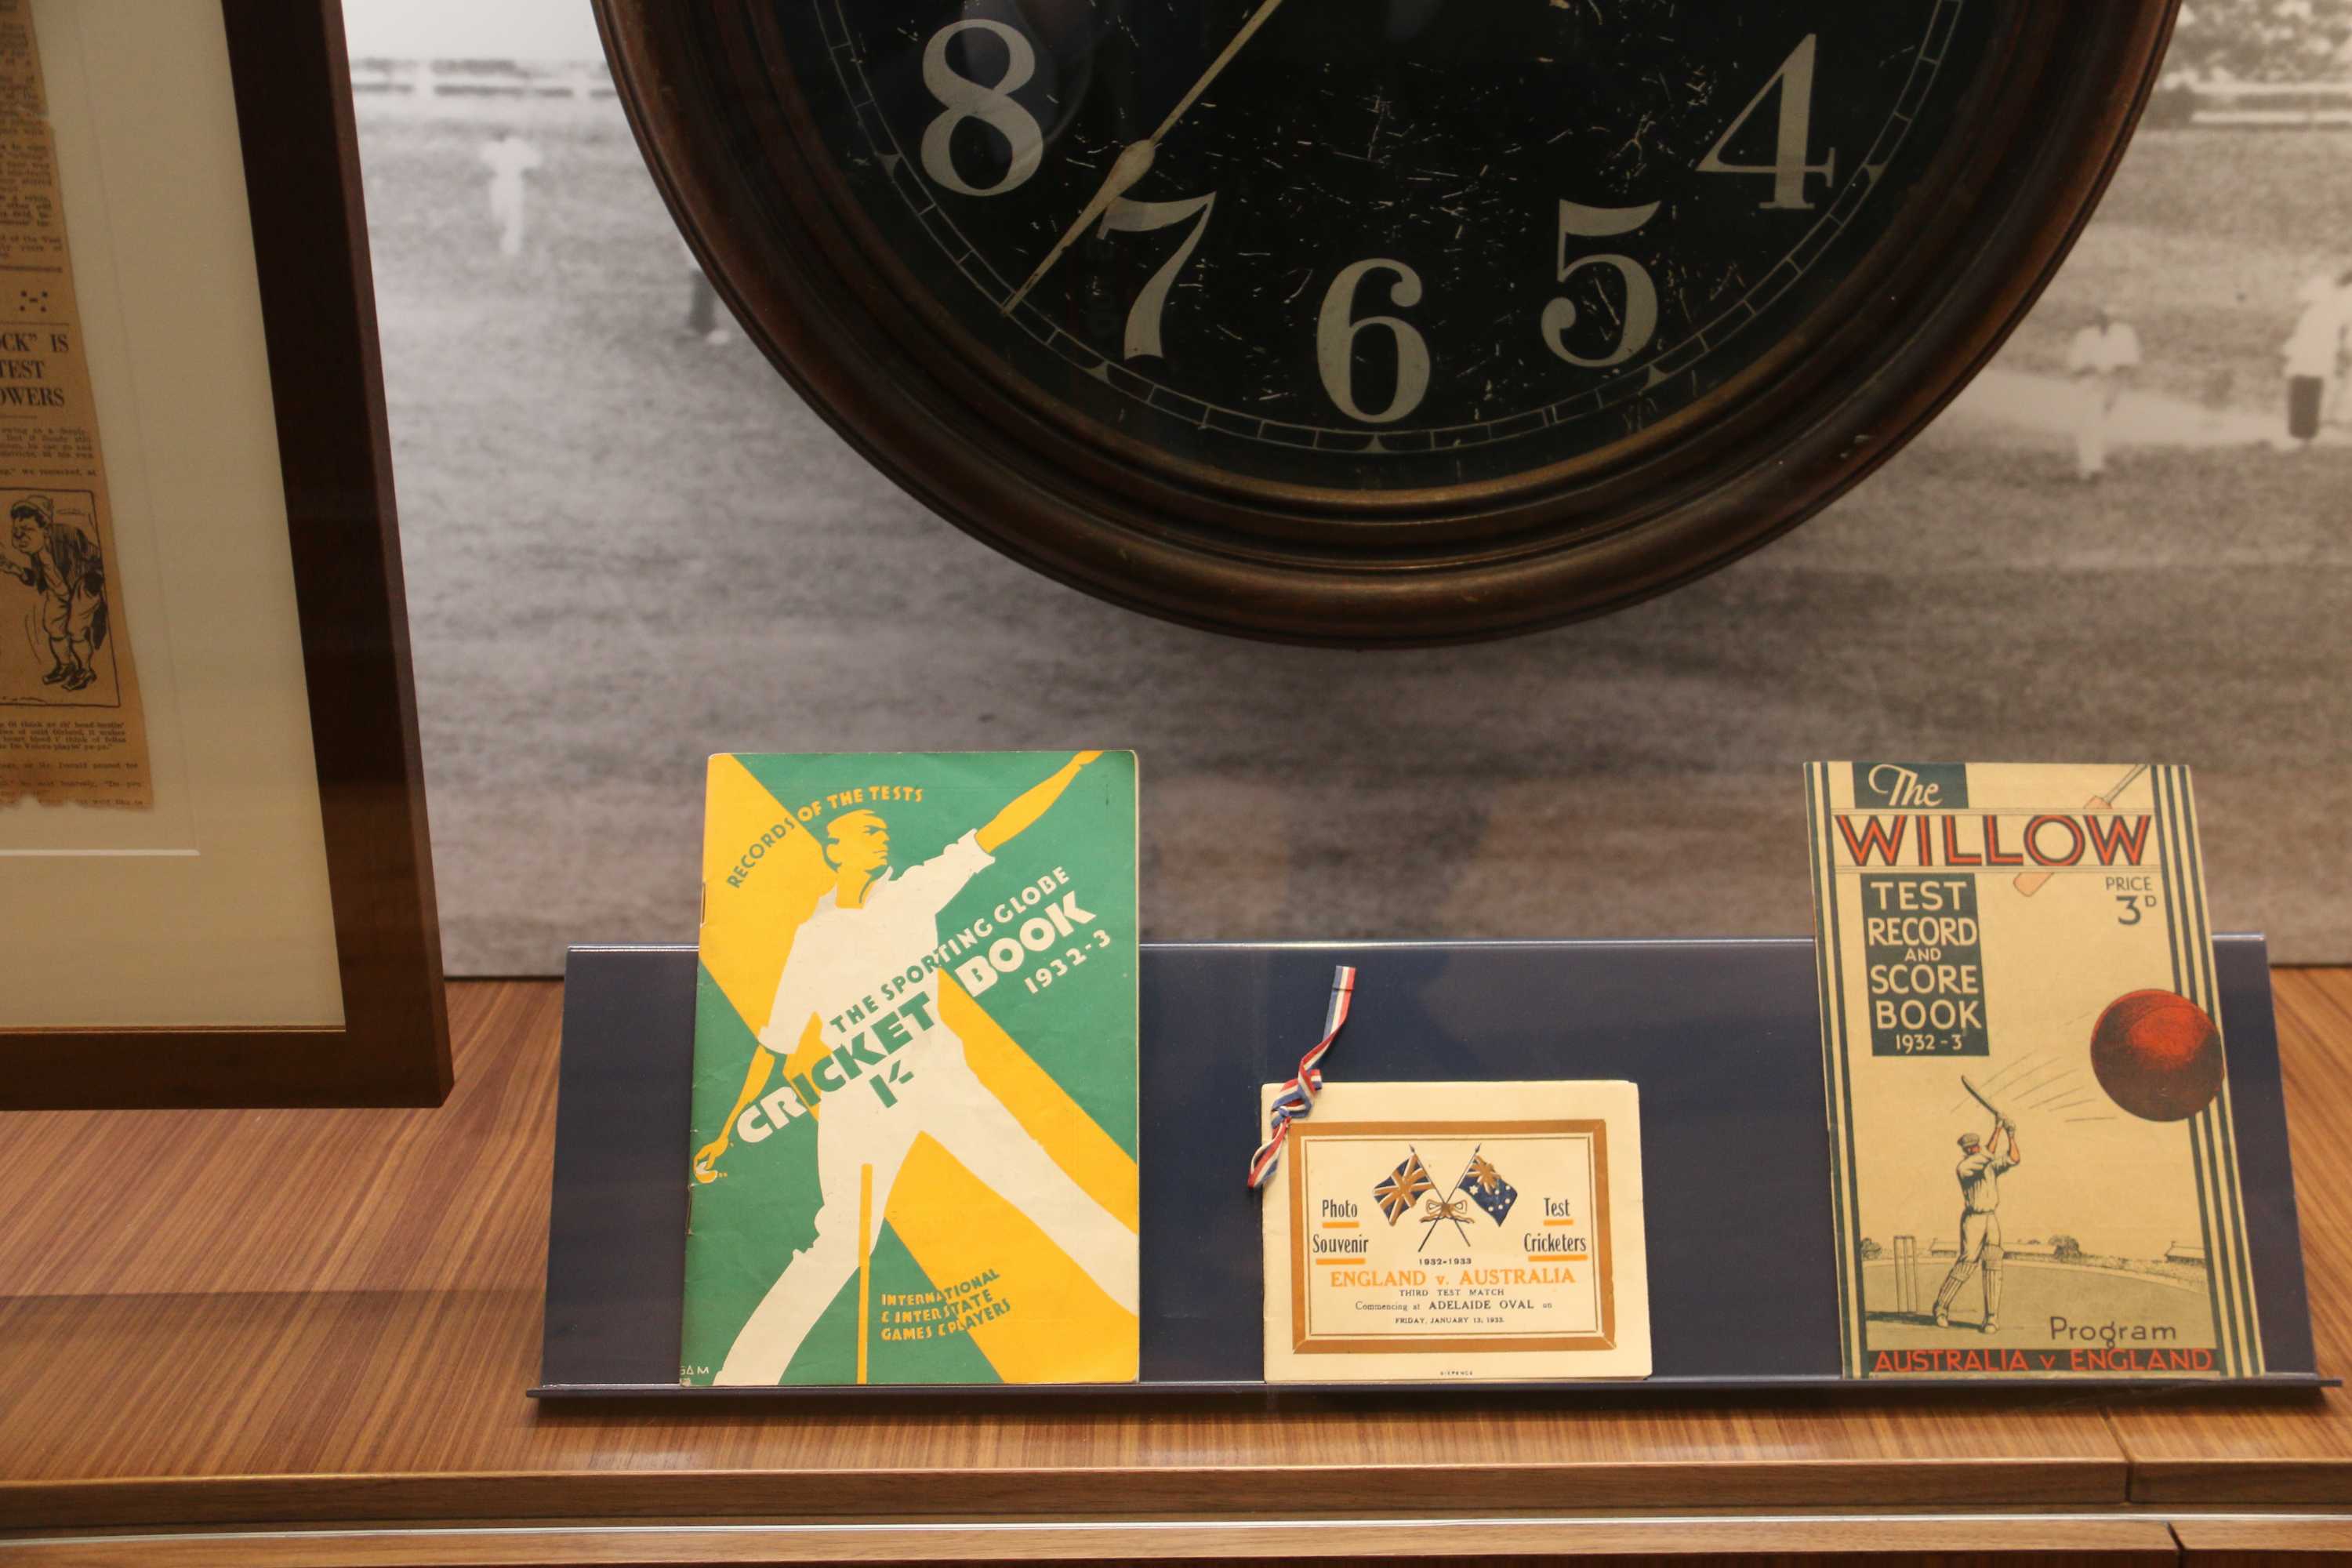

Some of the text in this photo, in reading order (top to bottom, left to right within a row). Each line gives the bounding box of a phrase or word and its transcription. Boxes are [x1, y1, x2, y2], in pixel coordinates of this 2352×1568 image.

[920, 18, 1044, 197] 8
[1693, 33, 1836, 210] 4
[1096, 191, 1217, 361] 7
[1540, 198, 1660, 368] 5
[50, 334, 70, 353] IS
[1316, 257, 1431, 424] 6
[1868, 764, 1943, 808] The
[726, 786, 924, 888] RECORDS OF THE TESTS
[1835, 815, 2151, 866] WILLOW
[1871, 881, 1967, 910] TEST
[2105, 876, 2153, 891] PRICE
[1867, 917, 1978, 946] RECORD
[829, 866, 1070, 1034] THE SPORTING GLOBE
[1904, 948, 1941, 962] AND
[1871, 965, 1980, 994] SCORE
[736, 890, 1096, 1144] CRICKET BOOK
[1875, 1000, 1982, 1030] BOOK
[1322, 1199, 1359, 1218] Photo
[1544, 1197, 1571, 1217] Test
[1312, 1234, 1370, 1254] Souvenir
[1524, 1232, 1587, 1253] Cricketers
[880, 1269, 1000, 1305] INTERNATIONAL
[1330, 1270, 1426, 1287] ENGLAND
[1459, 1268, 1577, 1286] AUSTRALIA
[895, 1289, 993, 1323] INTERSTATE
[1355, 1301, 1409, 1312] Commencing
[1428, 1301, 1491, 1311] ADELAIDE
[1499, 1300, 1534, 1310] OVAL
[1399, 1288, 1505, 1298] THIRD TEST MATCH
[880, 1325, 932, 1341] GAMES
[948, 1298, 1011, 1334] PLAYERS
[2049, 1316, 2177, 1349] Program
[1874, 1348, 2213, 1372] AUSTRALIA v ENGLAND
